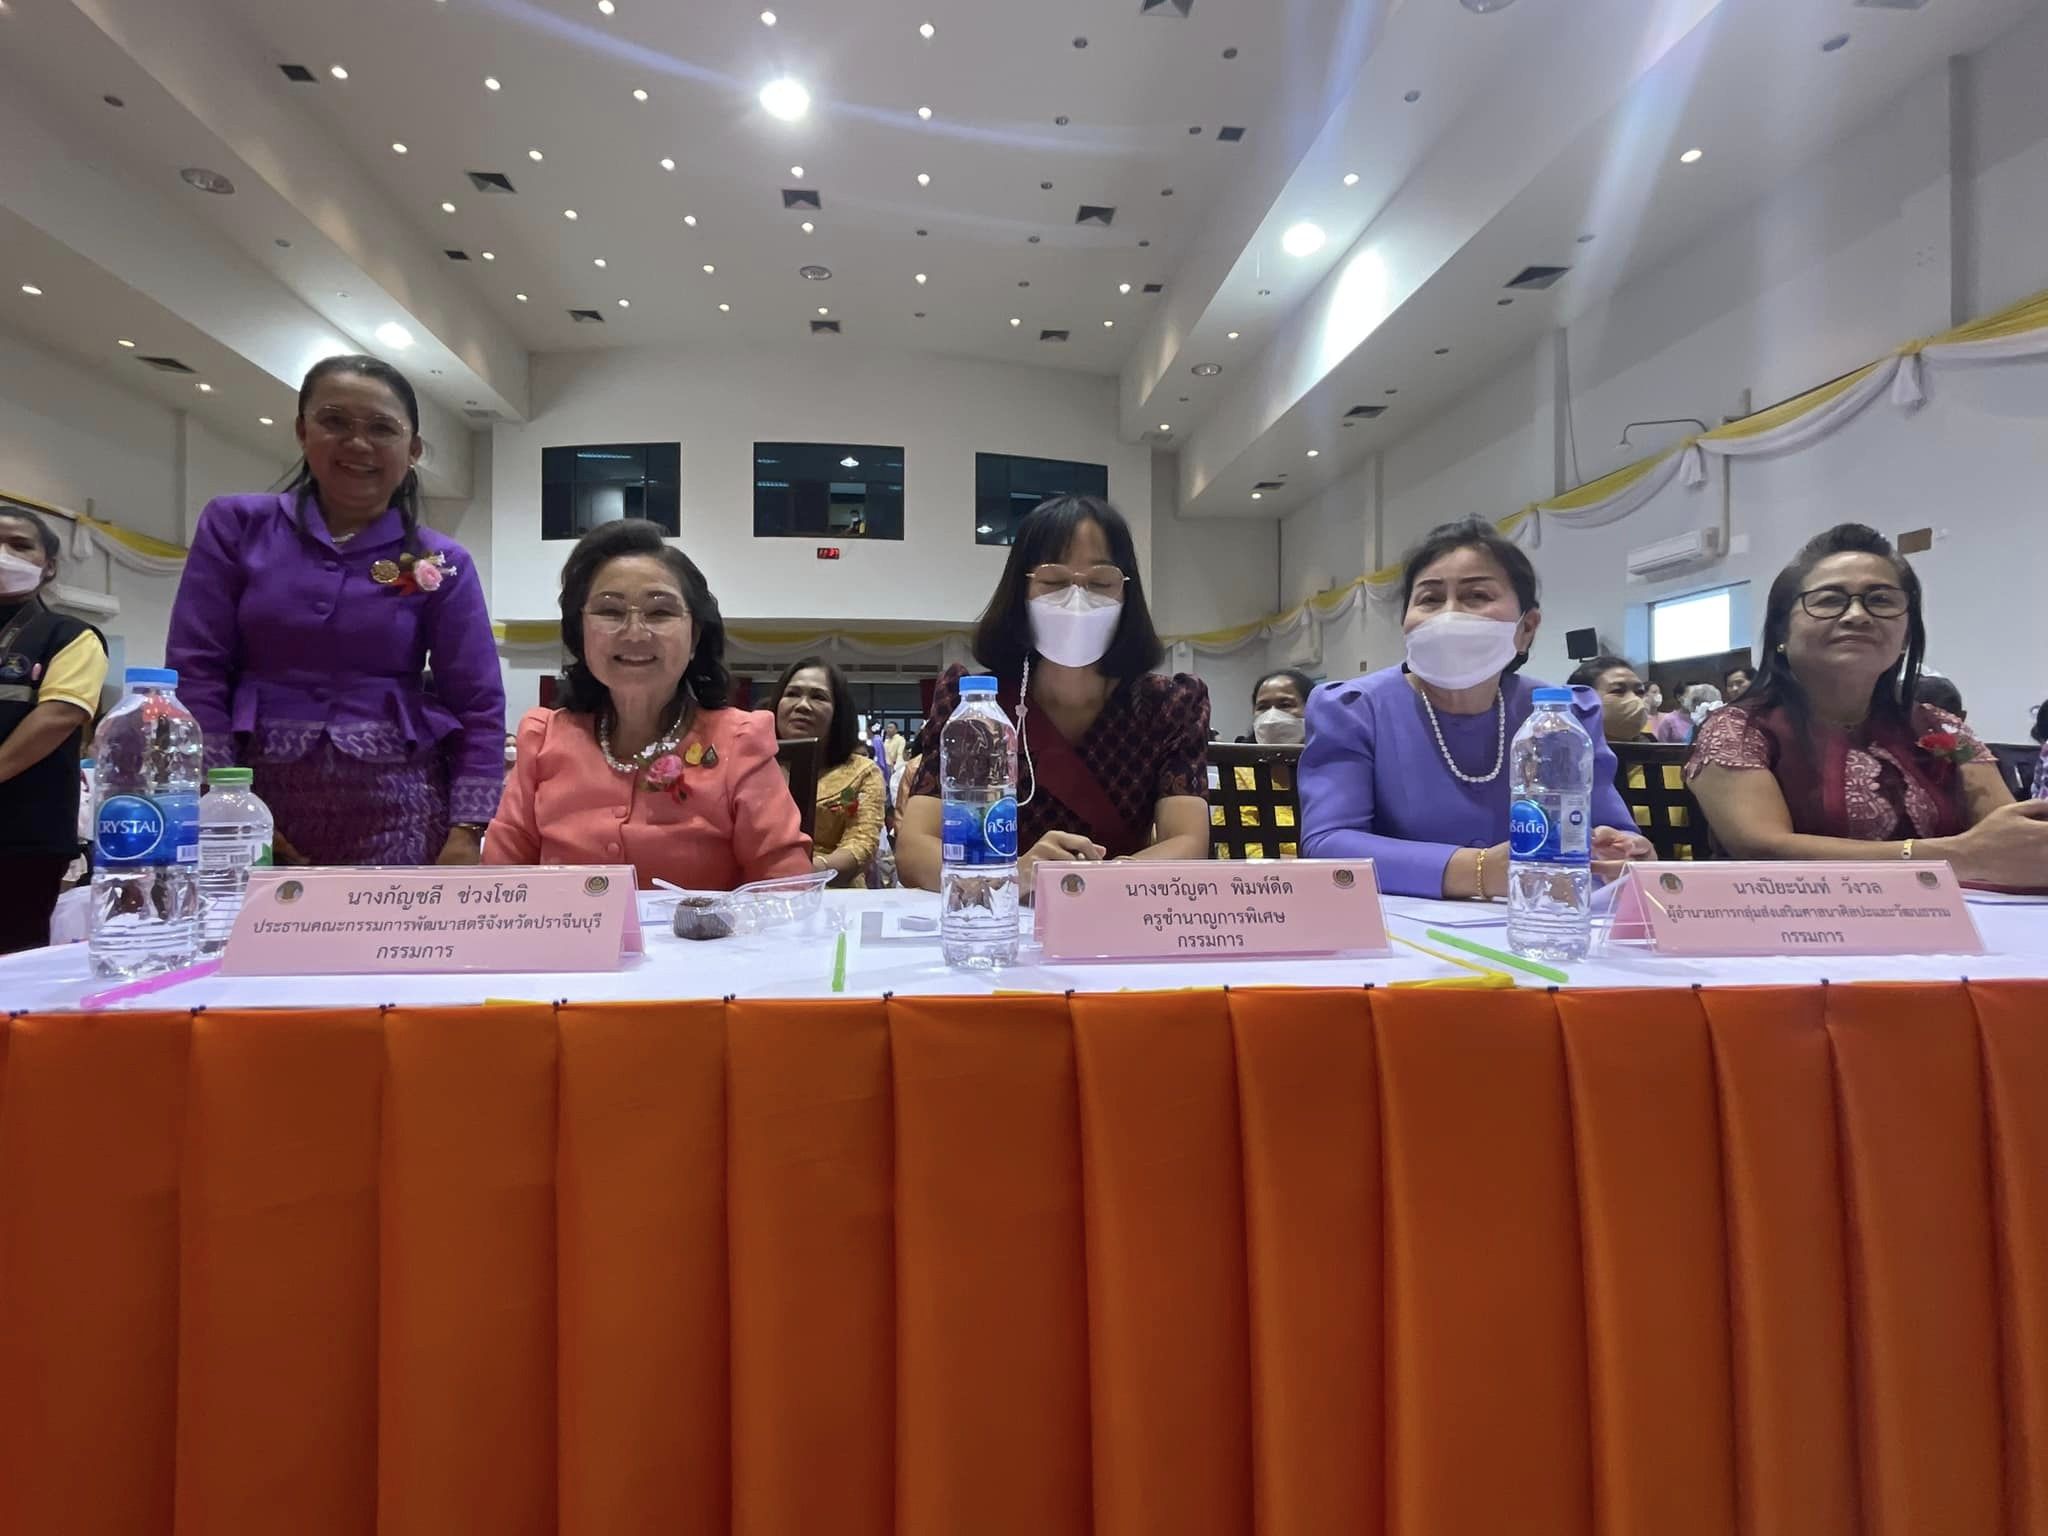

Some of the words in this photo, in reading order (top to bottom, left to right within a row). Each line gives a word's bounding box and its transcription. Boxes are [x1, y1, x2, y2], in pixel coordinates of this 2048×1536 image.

[1143, 906, 1286, 931] ครูชำนาญการพิเศษ
[1178, 934, 1245, 948] กรรมการ
[1781, 931, 1845, 944] กรรมการ
[376, 944, 455, 959] กรรมการ
